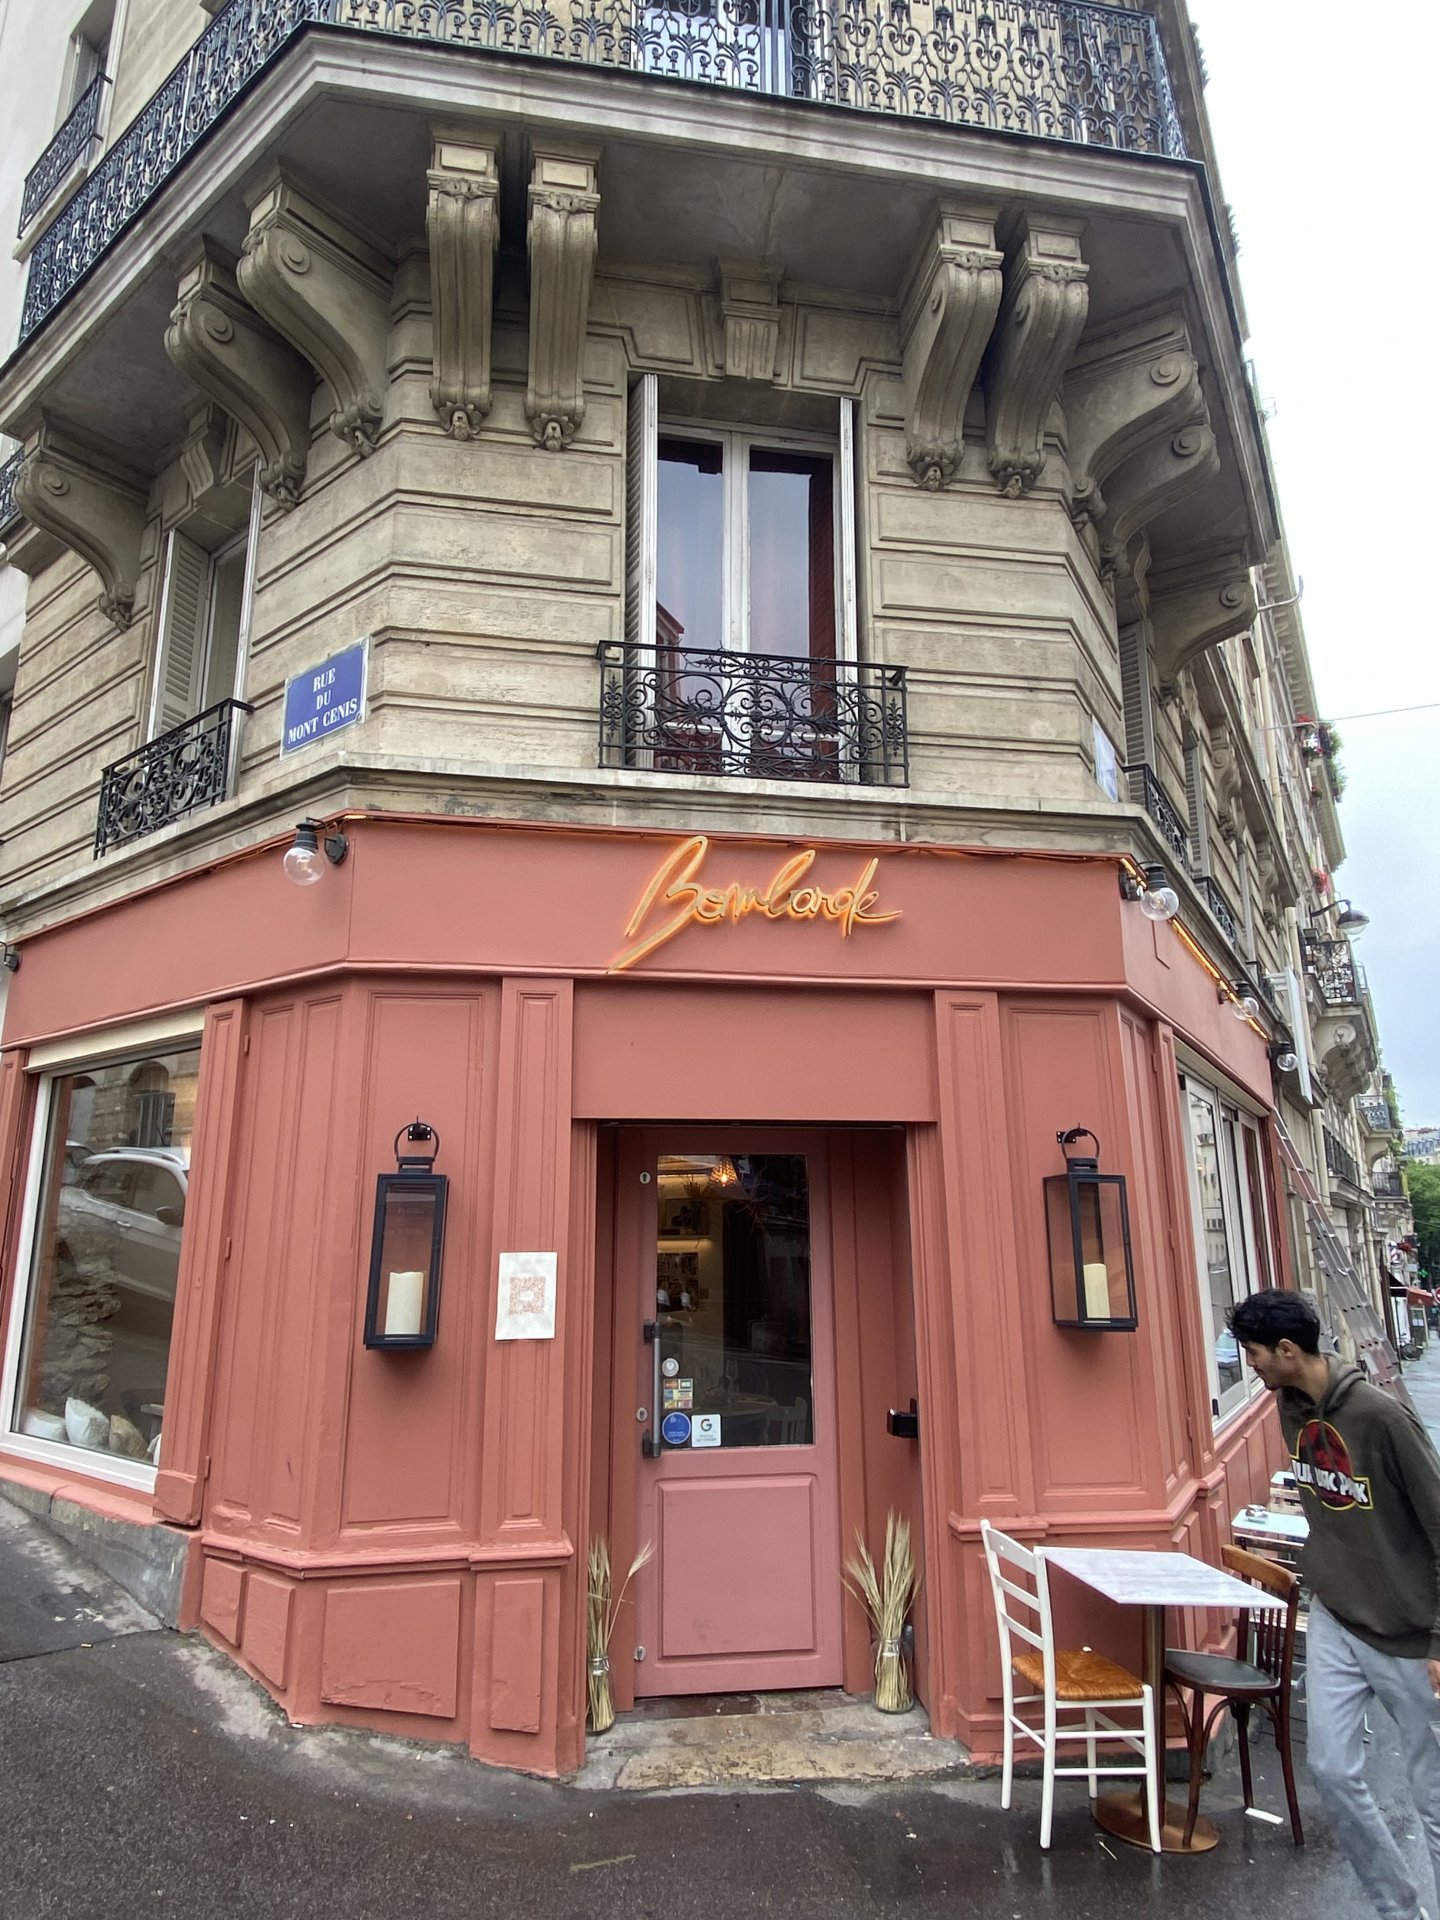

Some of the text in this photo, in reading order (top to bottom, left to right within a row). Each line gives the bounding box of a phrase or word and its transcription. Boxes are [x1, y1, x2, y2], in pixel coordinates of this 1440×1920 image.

[313, 668, 336, 692] RUE
[316, 690, 332, 711] DU
[288, 698, 358, 744] MONT CENIS
[701, 1418, 713, 1432] G
[1292, 1459, 1338, 1492] JUSSIC
